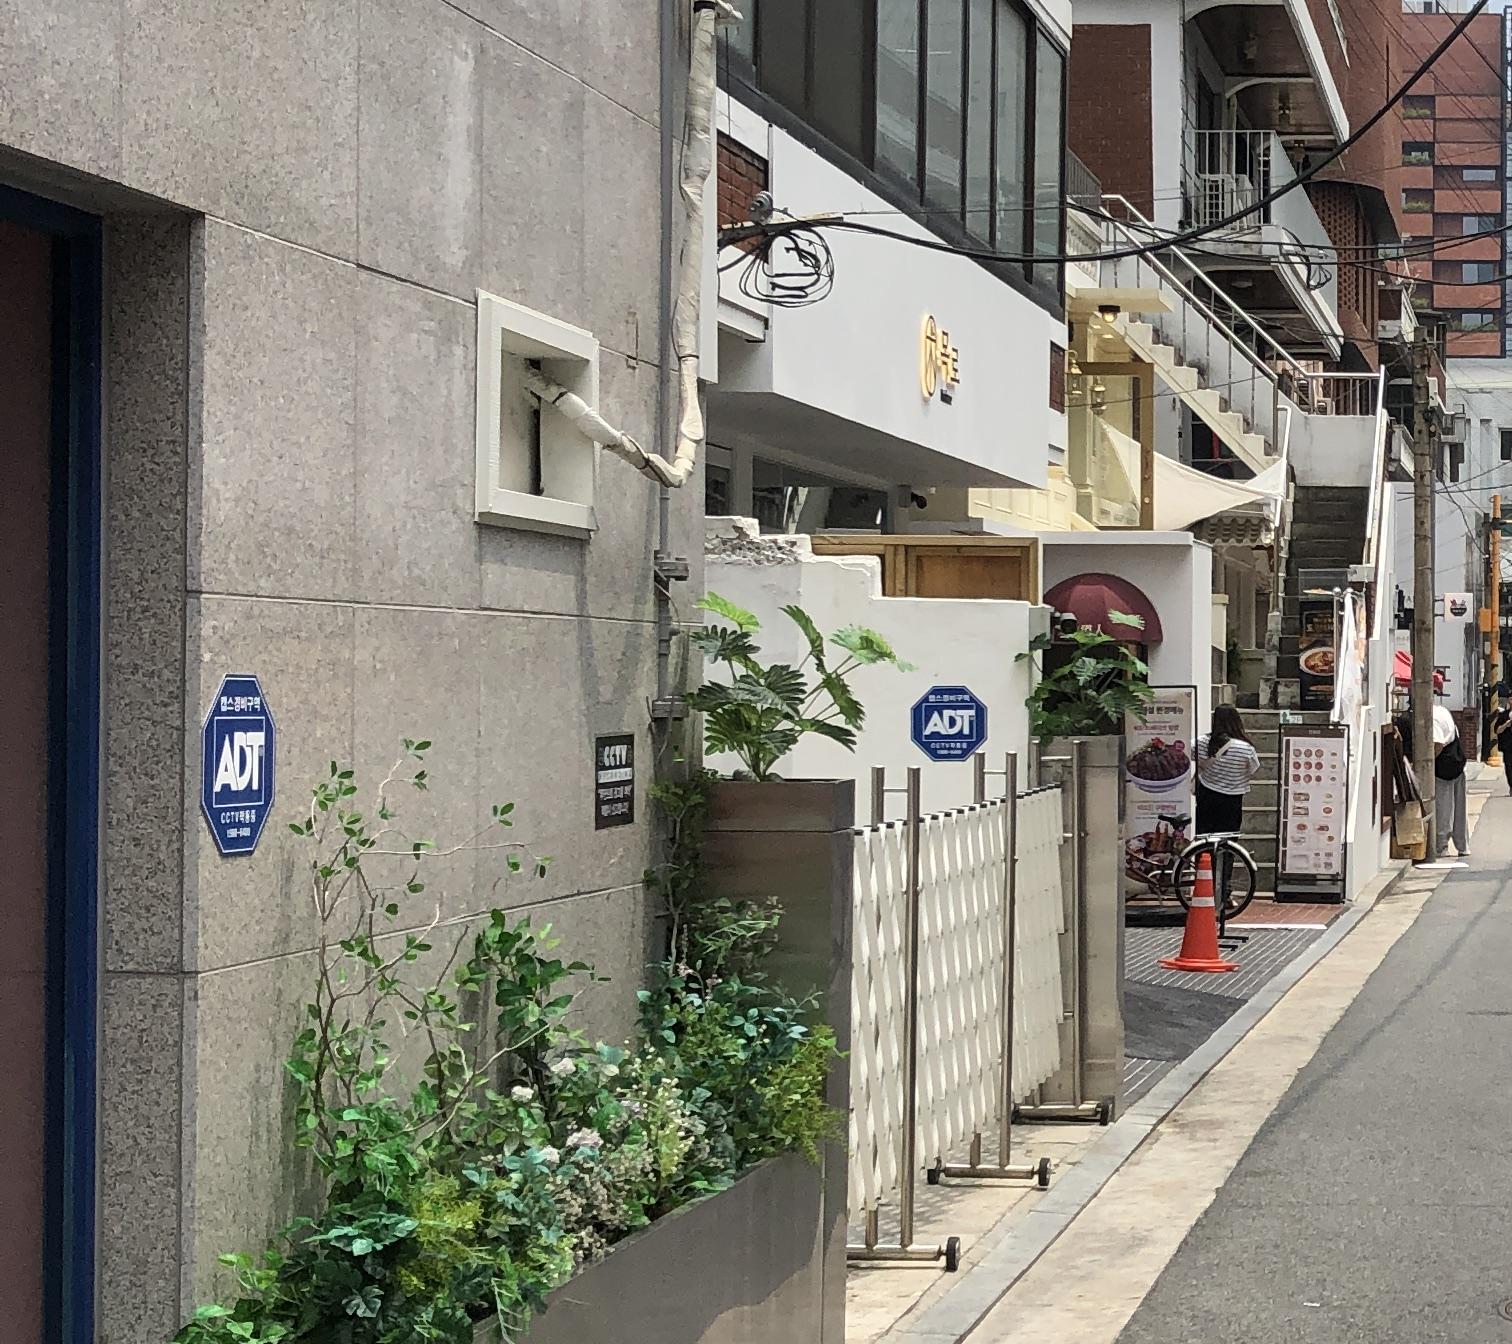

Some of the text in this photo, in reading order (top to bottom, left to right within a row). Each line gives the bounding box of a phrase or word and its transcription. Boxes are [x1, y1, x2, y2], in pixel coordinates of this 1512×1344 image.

[923, 709, 976, 735] ADT
[214, 731, 265, 792] ADT
[604, 744, 627, 767] CCTV
